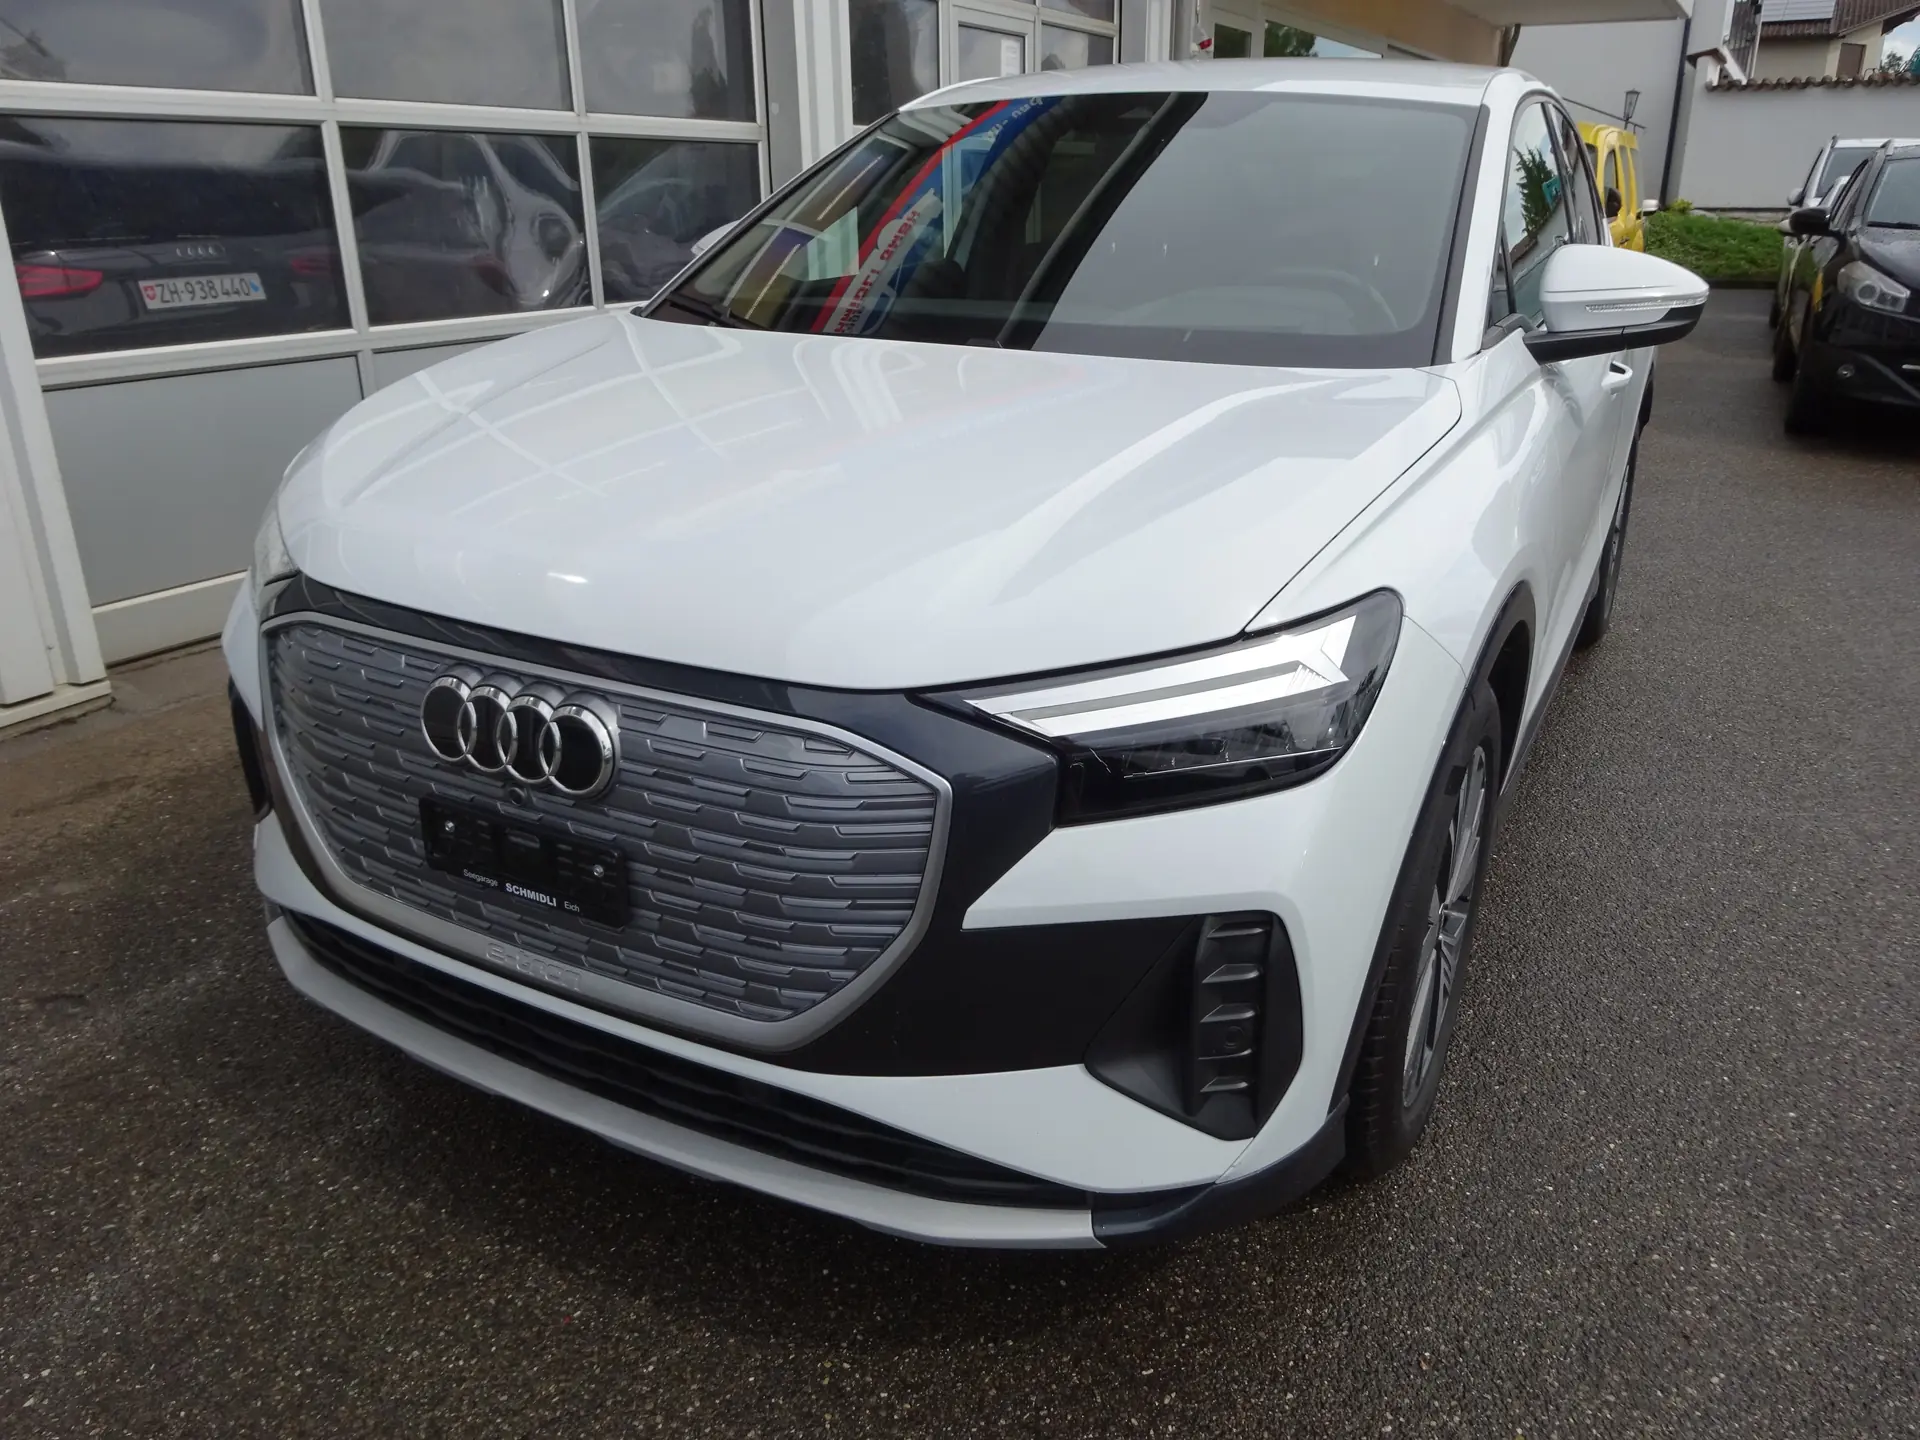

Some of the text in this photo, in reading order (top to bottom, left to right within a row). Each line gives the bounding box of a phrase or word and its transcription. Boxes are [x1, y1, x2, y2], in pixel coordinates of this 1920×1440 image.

[505, 882, 556, 907] SCHMIDLI
[564, 901, 580, 912] Eich
[486, 942, 584, 993] e-tron
